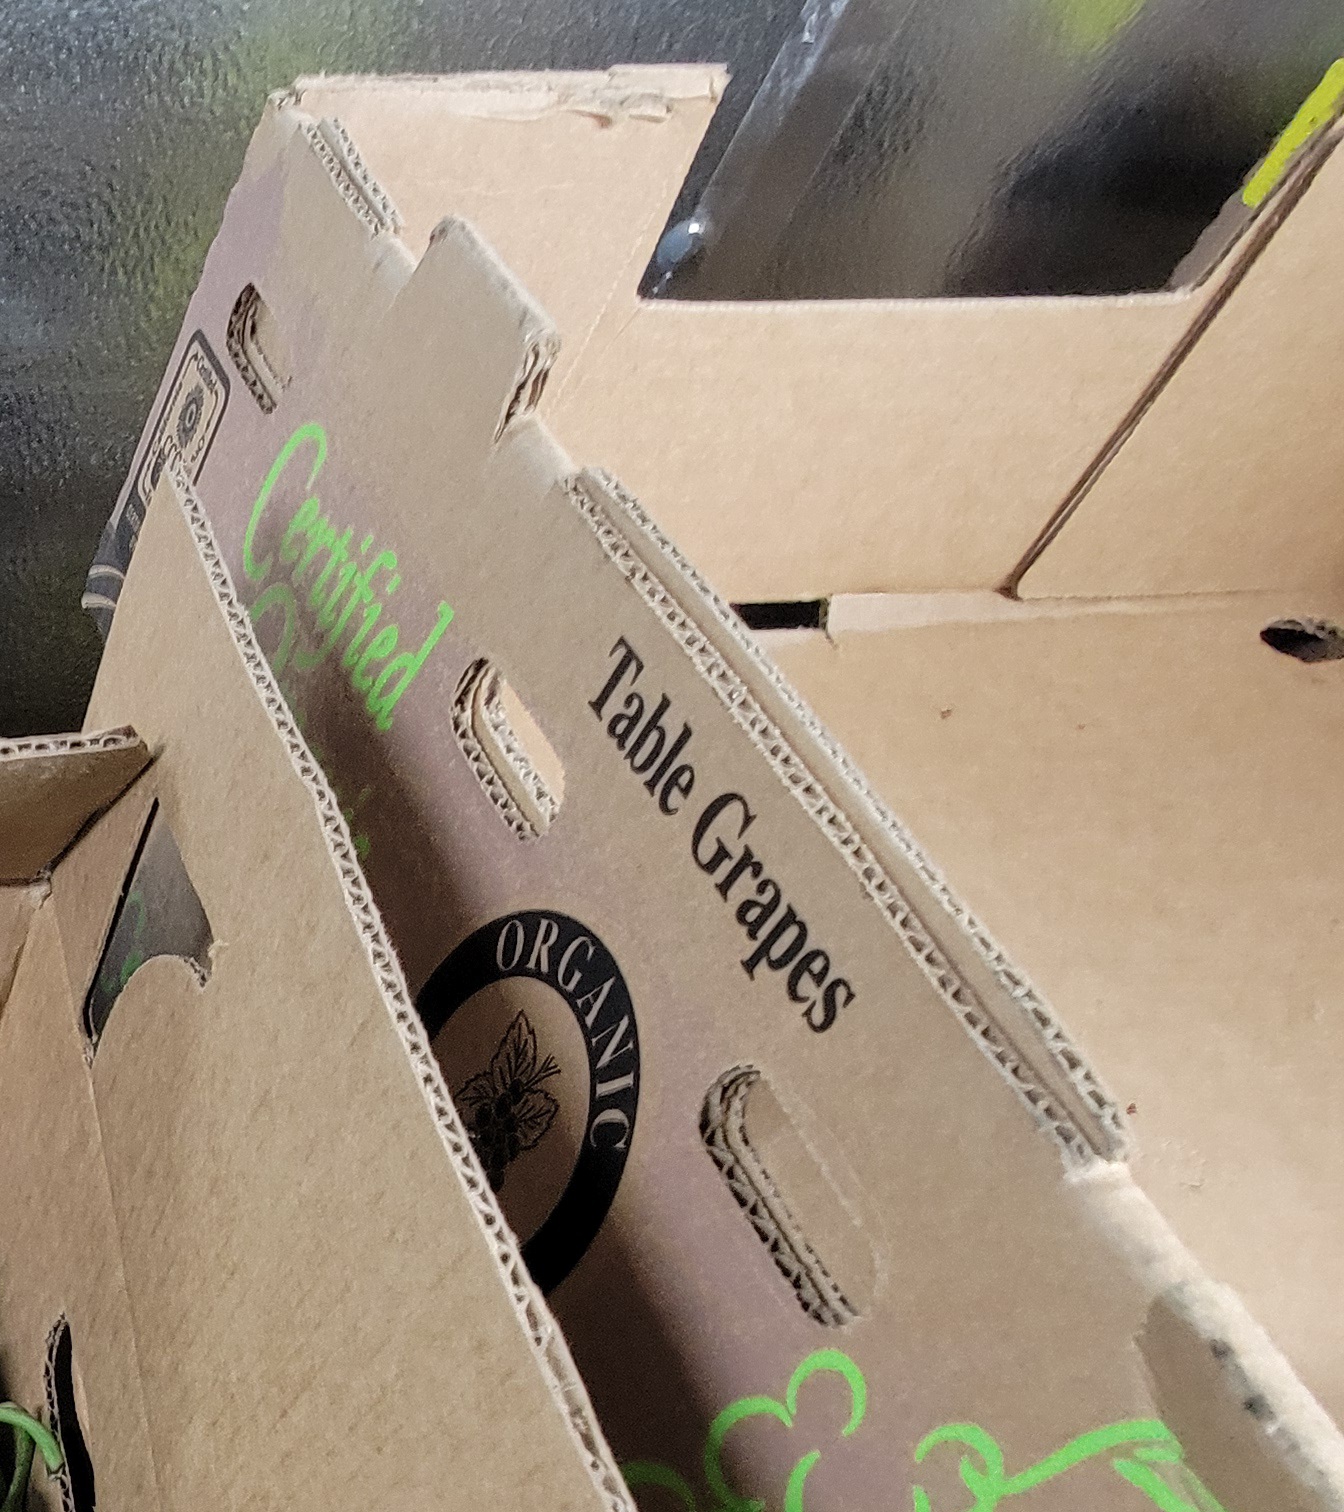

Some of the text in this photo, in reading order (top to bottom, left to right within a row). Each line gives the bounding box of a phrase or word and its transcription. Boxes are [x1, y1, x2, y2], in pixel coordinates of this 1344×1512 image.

[241, 422, 455, 731] Certified
[586, 636, 856, 1035] Table Grapes
[494, 917, 630, 1153] ORGANIC
